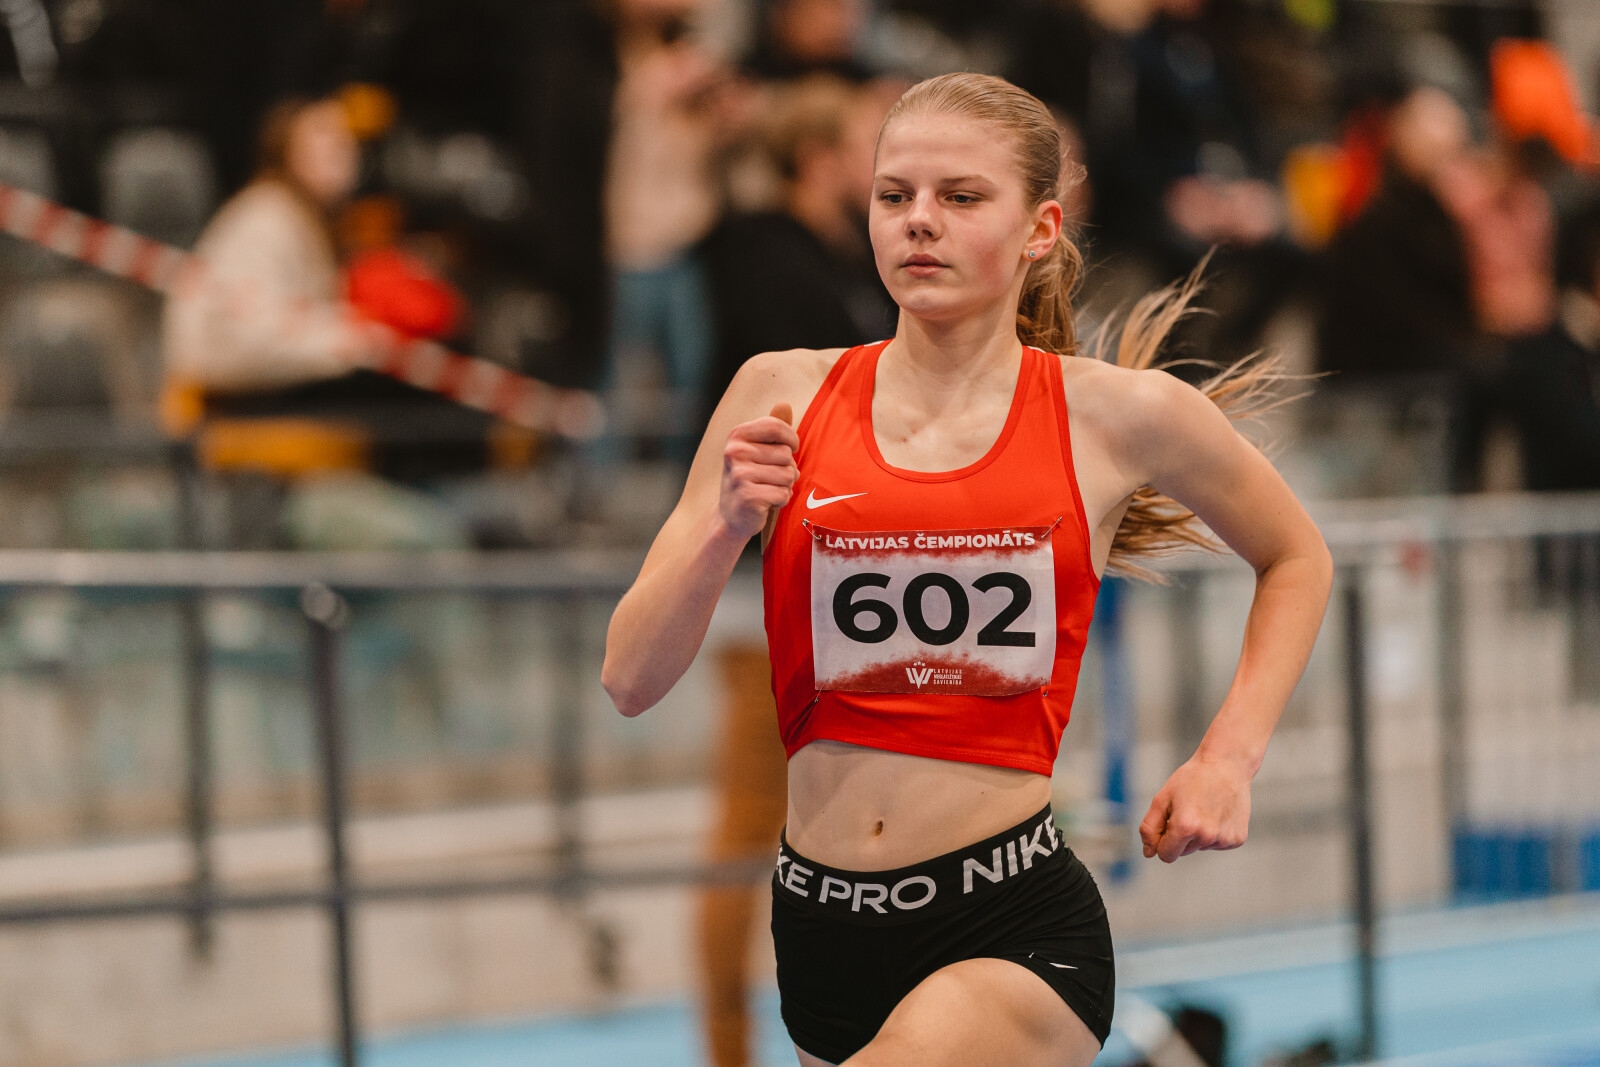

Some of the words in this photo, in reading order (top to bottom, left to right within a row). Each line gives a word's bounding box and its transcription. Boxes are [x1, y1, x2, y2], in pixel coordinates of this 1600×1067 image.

[826, 534, 910, 550] LATVIJAS
[914, 529, 1036, 549] ČEMPIONĀTS
[832, 571, 1036, 648] 602
[776, 843, 814, 898] KE
[818, 875, 937, 914] PRO
[963, 814, 1059, 894] NIKE
